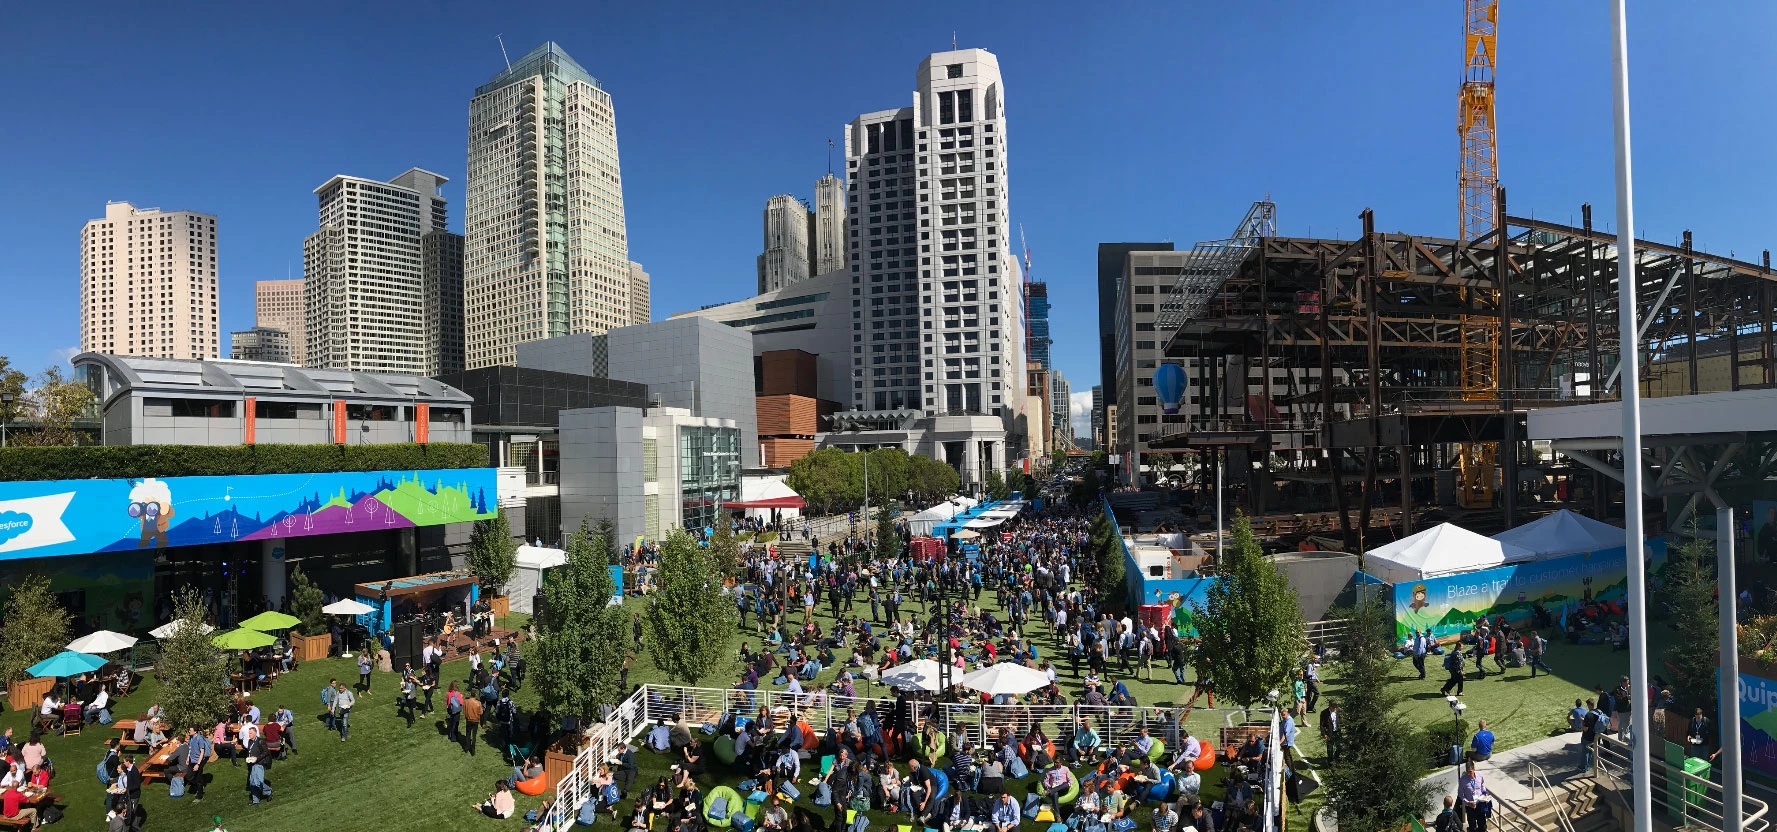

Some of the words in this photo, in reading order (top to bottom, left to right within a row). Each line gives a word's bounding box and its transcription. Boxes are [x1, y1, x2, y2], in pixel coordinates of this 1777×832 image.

[1447, 584, 1478, 599] Blaze
[1481, 582, 1488, 593] a
[1491, 575, 1512, 591] trail
[1515, 575, 1526, 587] to
[1529, 566, 1579, 584] customer
